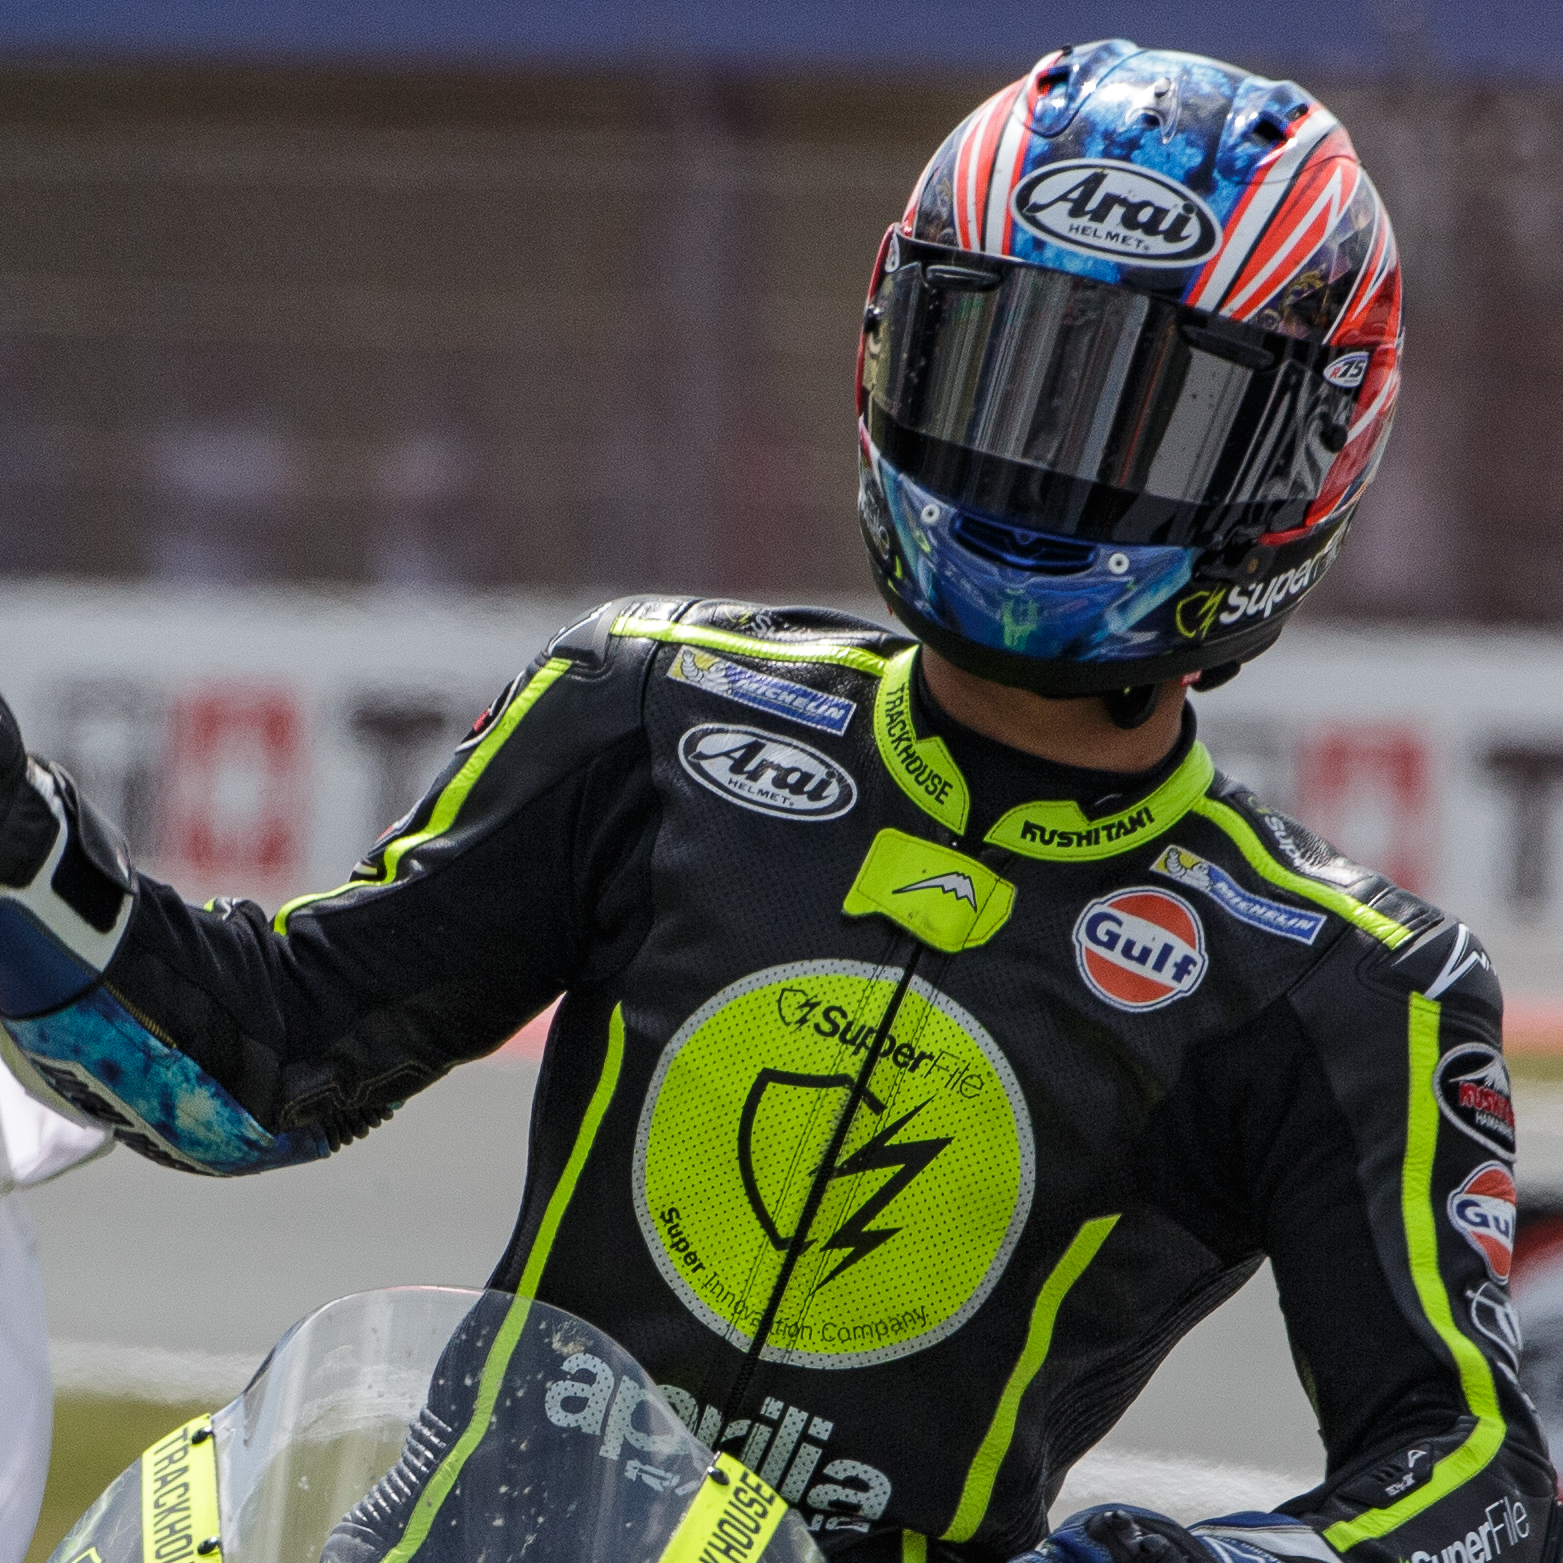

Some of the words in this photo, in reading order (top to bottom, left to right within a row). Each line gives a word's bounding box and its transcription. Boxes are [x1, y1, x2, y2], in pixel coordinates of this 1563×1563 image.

[1022, 171, 1192, 243] Arai
[1068, 222, 1146, 249] HELMET
[739, 678, 845, 721] MICHELIN
[687, 738, 838, 802] Arai
[885, 682, 953, 805] TRACKHOUSE
[727, 776, 790, 804] HELMET
[1020, 806, 1155, 848] KUSHITANI
[1213, 880, 1316, 931] MICHELIN
[1085, 911, 1197, 984] Gulf
[813, 1005, 985, 1099] SuperFile
[659, 1206, 706, 1274] Super
[821, 1304, 927, 1342] Company
[544, 1352, 892, 1521] aprilia
